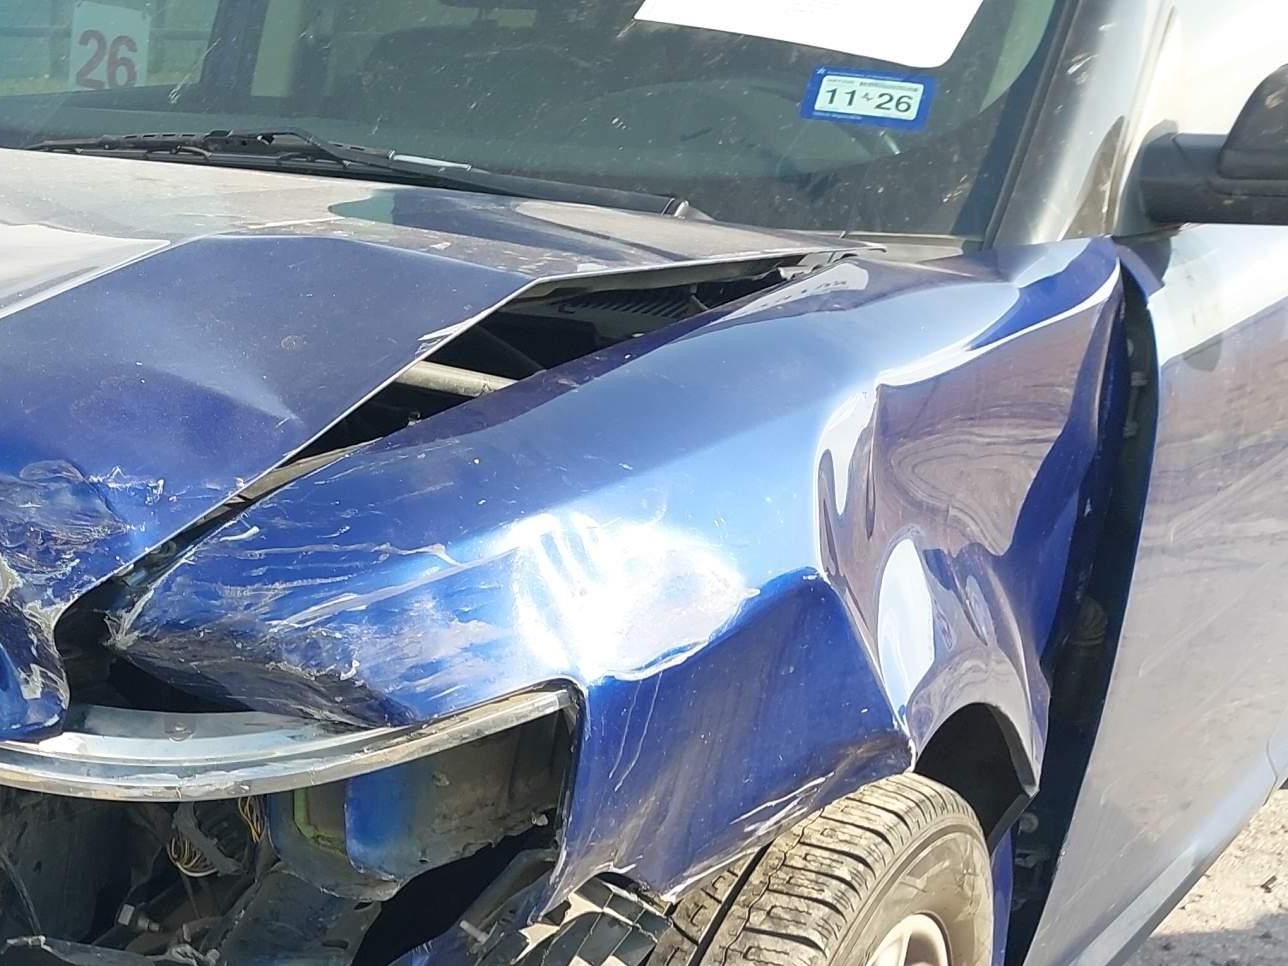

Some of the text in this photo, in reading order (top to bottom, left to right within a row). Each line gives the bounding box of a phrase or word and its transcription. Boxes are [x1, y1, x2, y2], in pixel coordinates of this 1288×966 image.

[76, 29, 137, 89] 26
[825, 87, 914, 113] 11 26
